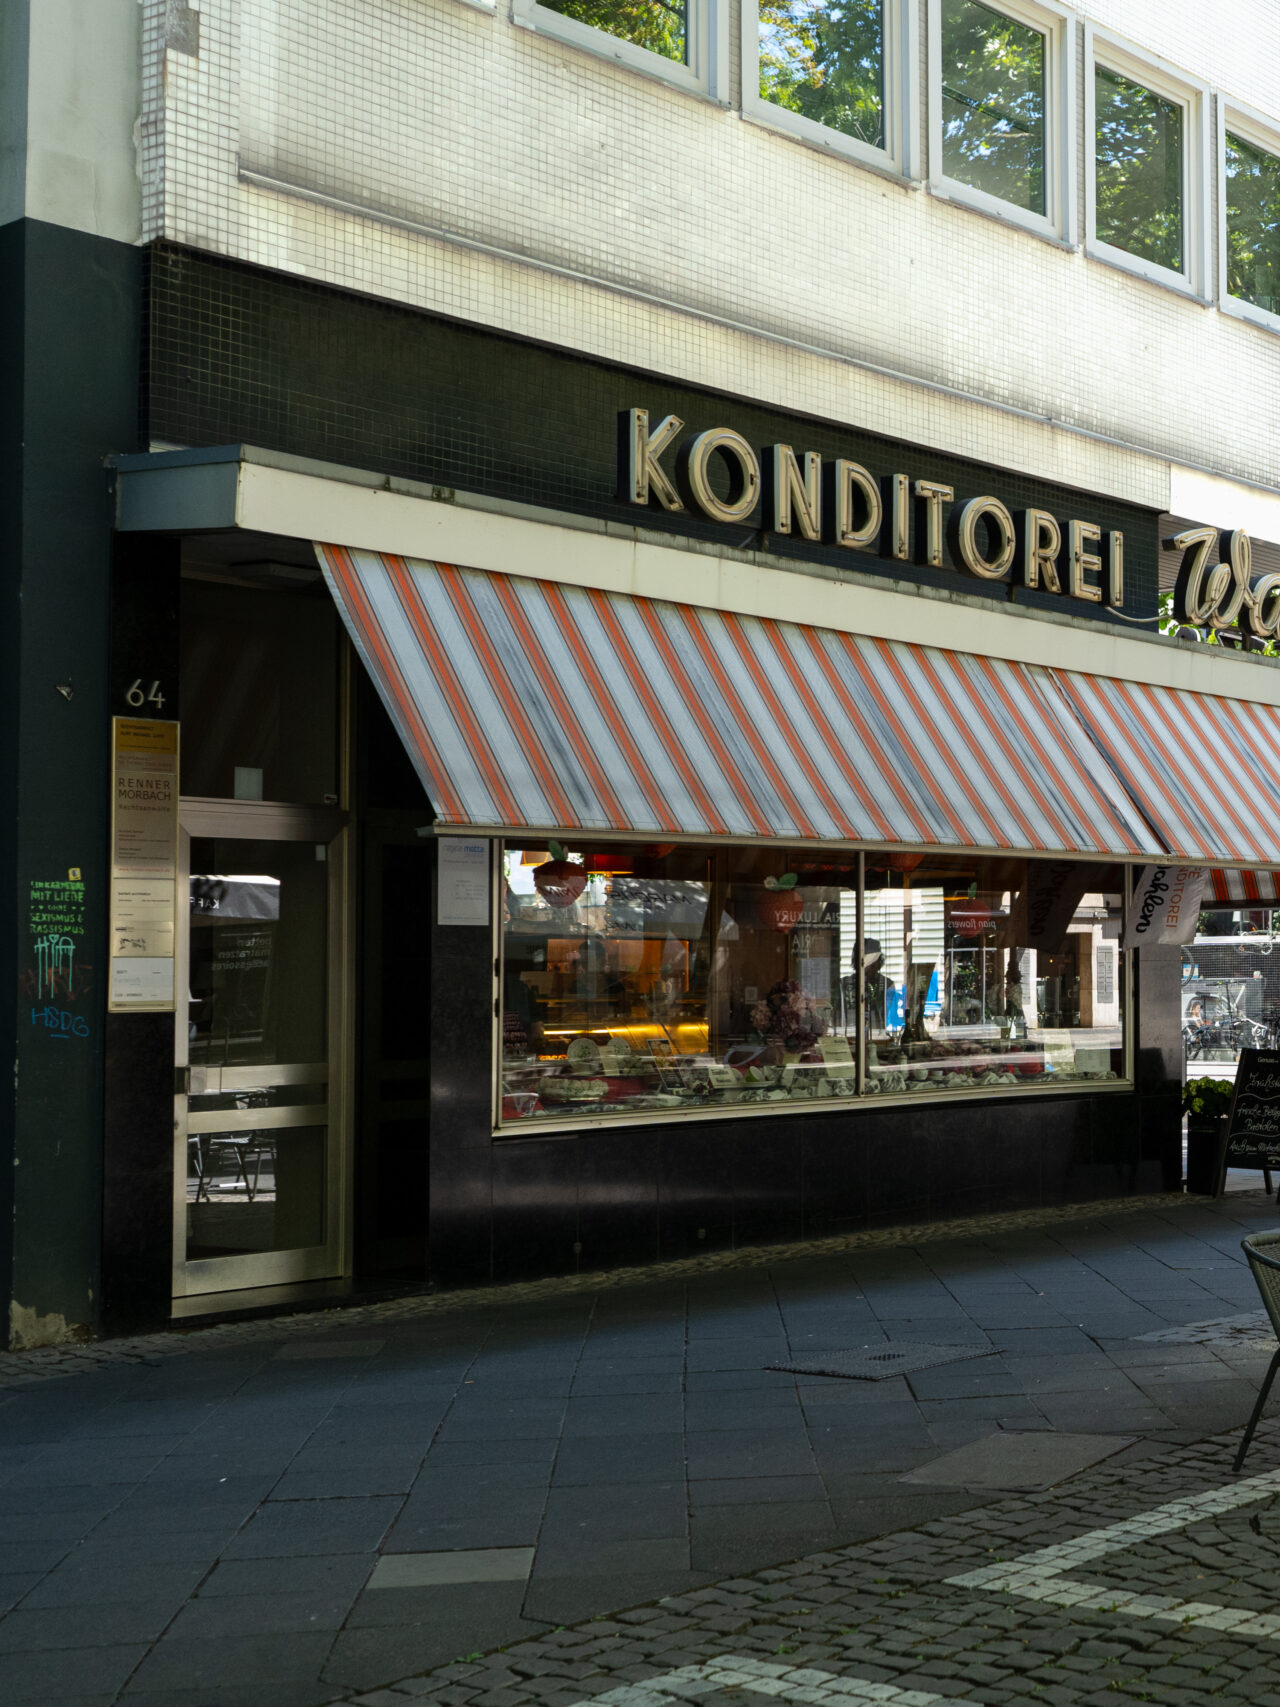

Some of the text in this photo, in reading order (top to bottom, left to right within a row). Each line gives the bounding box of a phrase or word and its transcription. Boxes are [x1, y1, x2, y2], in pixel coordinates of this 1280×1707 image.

[618, 408, 1124, 604] KONDITOREI
[125, 678, 166, 709] 64
[118, 776, 171, 790] RENNER
[118, 789, 171, 801] MORBACH
[30, 890, 52, 901] MIT
[30, 912, 75, 923] SEXISMUS
[29, 923, 85, 935] RASSISMUS
